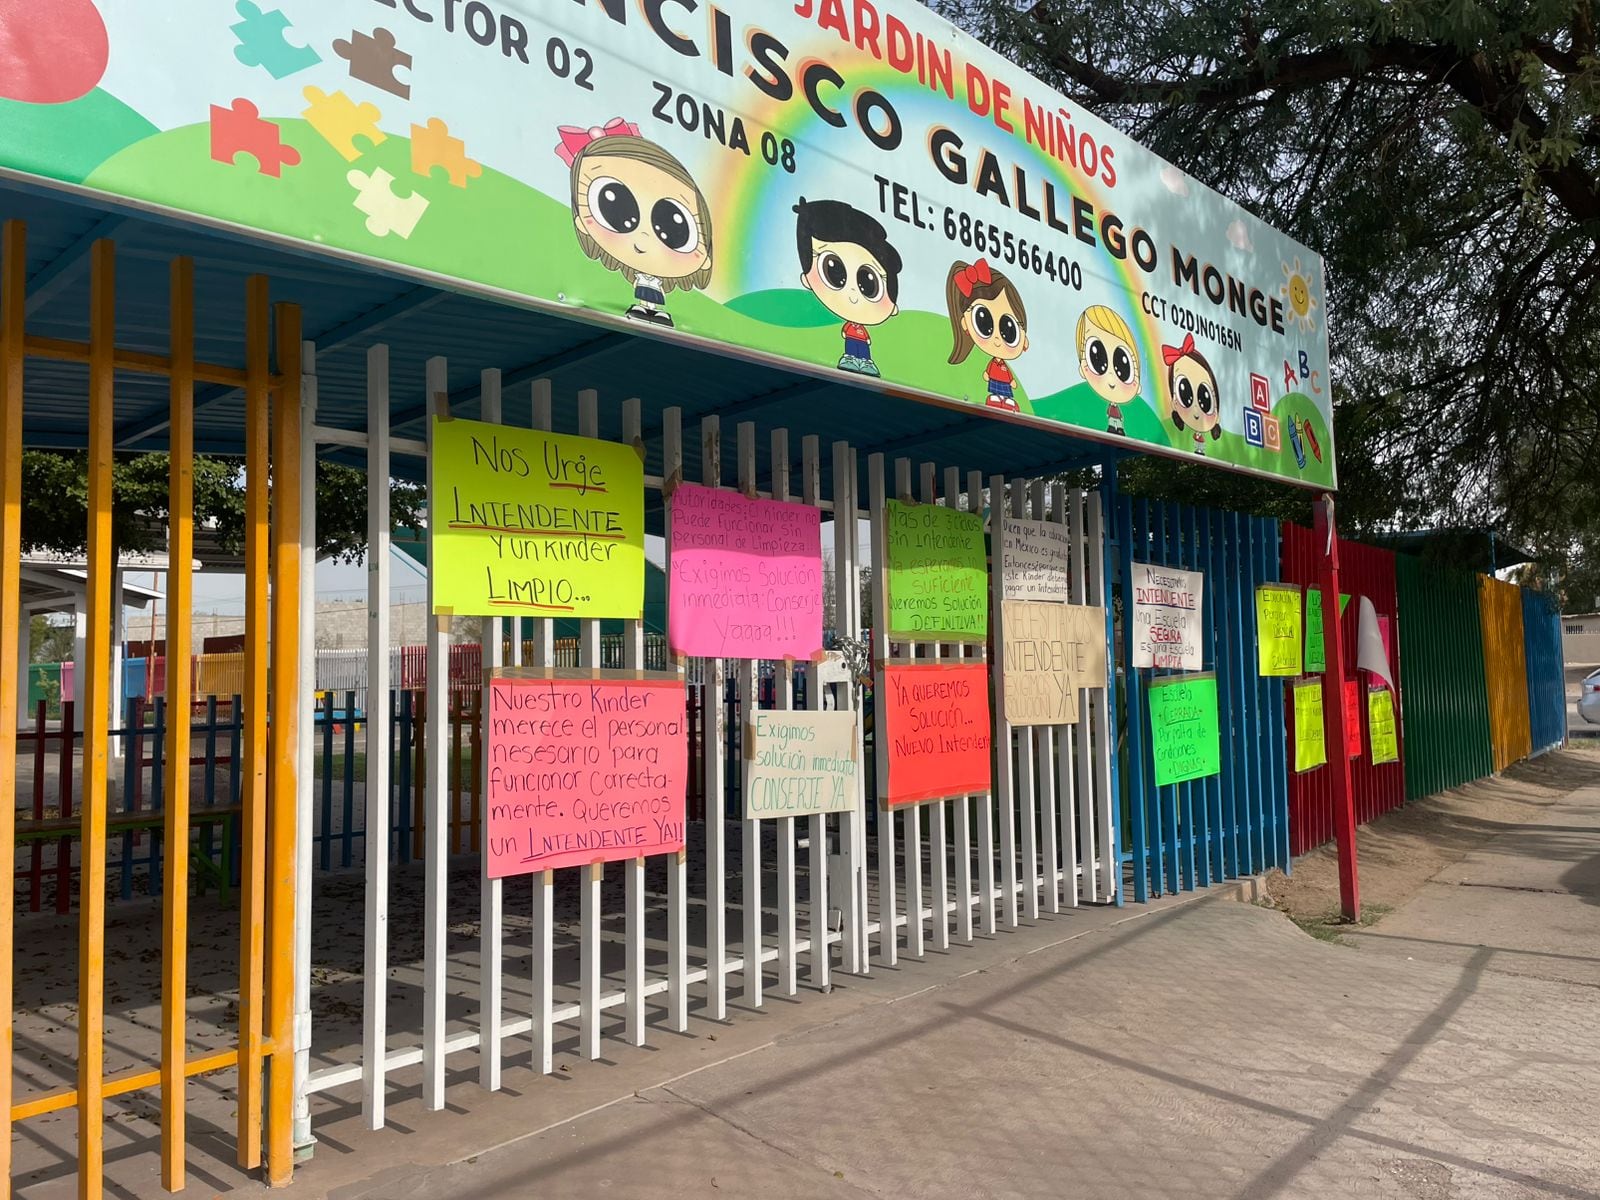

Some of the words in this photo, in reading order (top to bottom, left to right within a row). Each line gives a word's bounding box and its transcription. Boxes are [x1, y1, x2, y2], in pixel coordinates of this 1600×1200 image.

[546, 37, 594, 91] 02
[652, 81, 751, 156] ZONA
[761, 131, 797, 174] 08
[965, 62, 1014, 134] DE
[1024, 97, 1116, 188] NIÑOS
[874, 174, 934, 232] TEL:
[943, 207, 1082, 291] 6865566400
[928, 126, 1158, 273] GALLEGO
[1172, 245, 1285, 336] MONGE
[1142, 291, 1167, 322] CCT
[1171, 306, 1242, 353] 02DJN0165N
[1284, 360, 1298, 392] A
[1299, 351, 1309, 379] B
[1311, 372, 1321, 393] C
[471, 435, 529, 477] Nos
[544, 440, 606, 496] Urge
[449, 486, 623, 532] INTENDENTE
[672, 509, 711, 529] Puede
[923, 507, 938, 528] de
[490, 535, 503, 559] Y
[735, 538, 746, 549] de
[1023, 526, 1037, 540] que
[1040, 523, 1047, 537] la
[1150, 626, 1182, 643] SEGURA
[1005, 640, 1085, 672] INTENDENTE
[493, 682, 582, 712] Nuestro
[591, 684, 656, 714] Kinder
[912, 680, 970, 703] QUEREMOS
[1053, 673, 1076, 719] YA
[493, 718, 574, 738] merece
[581, 715, 598, 738] el
[608, 714, 684, 750] personal
[756, 715, 816, 750] Exigimos
[895, 735, 934, 758] NUEVO
[493, 744, 600, 766] nesesario
[612, 745, 658, 768] para
[492, 796, 564, 821] mente.
[573, 796, 672, 824] Queremos
[751, 777, 824, 812] CONSERJE
[830, 776, 846, 809] YA
[522, 825, 648, 861] INTENDENTE
[653, 816, 685, 845] YA!!
